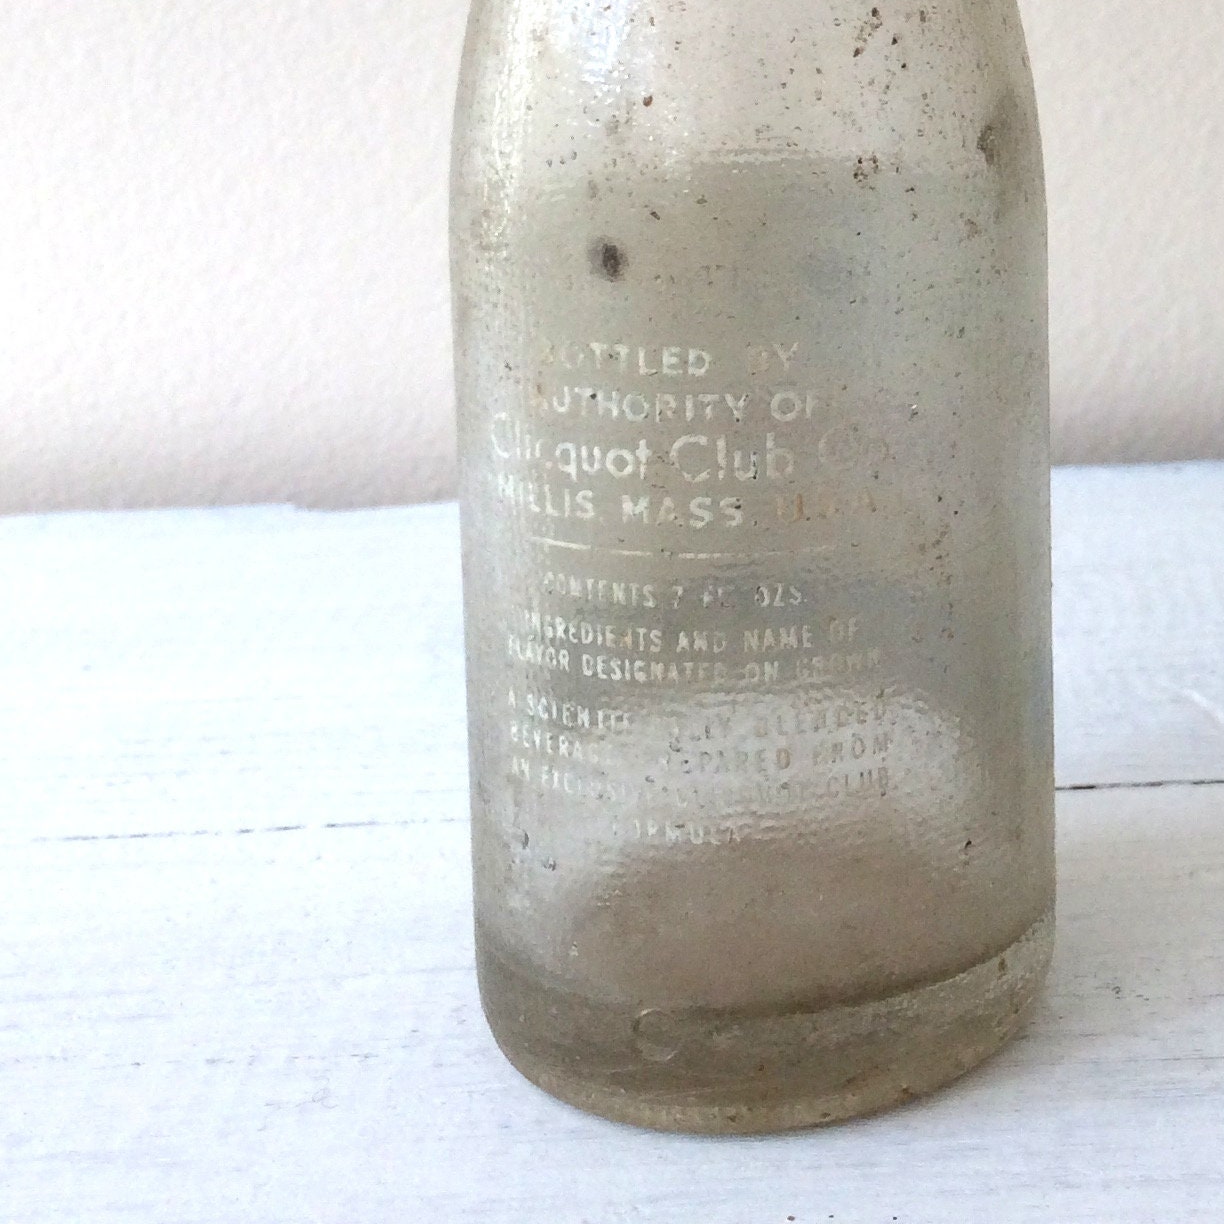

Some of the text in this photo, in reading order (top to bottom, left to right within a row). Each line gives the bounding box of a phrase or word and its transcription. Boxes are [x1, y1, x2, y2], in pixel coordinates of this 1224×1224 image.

[544, 340, 713, 377] OTTLED
[669, 431, 797, 483] Club
[743, 623, 814, 653] NAME
